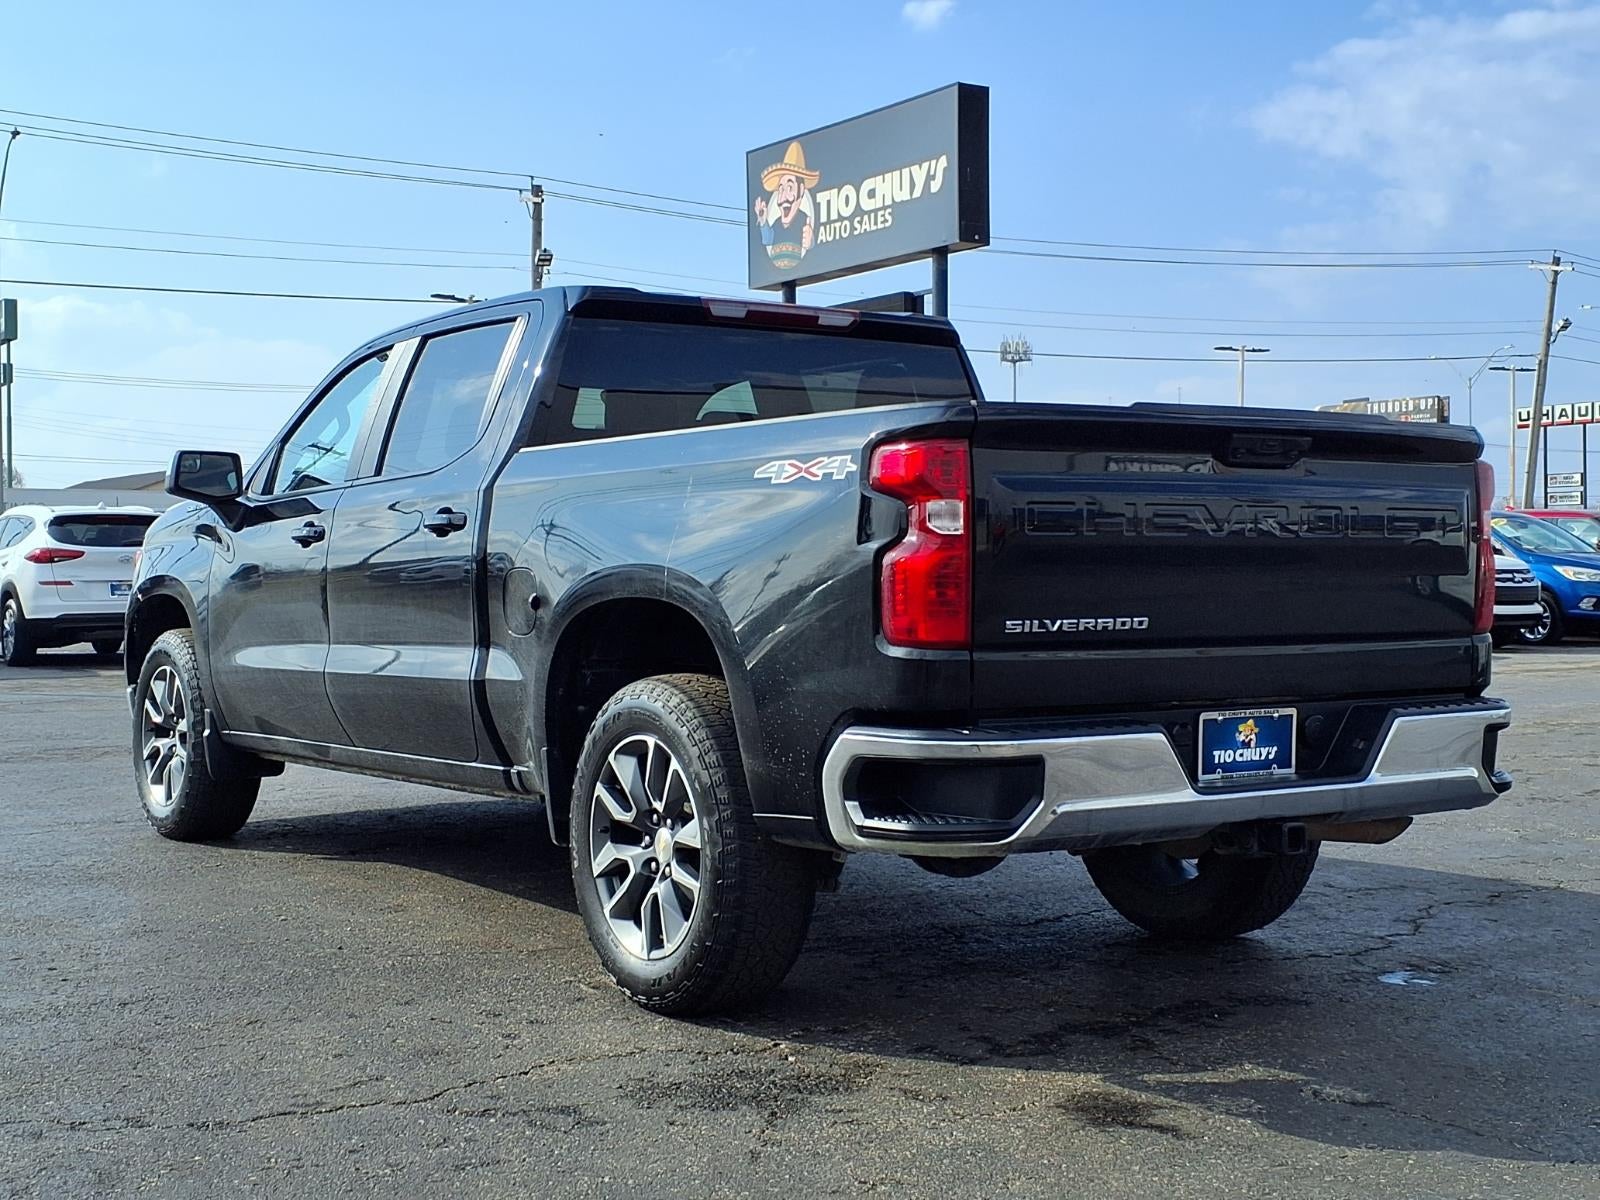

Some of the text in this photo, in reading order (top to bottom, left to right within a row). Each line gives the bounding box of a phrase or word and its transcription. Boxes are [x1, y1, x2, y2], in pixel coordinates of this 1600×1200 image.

[816, 154, 948, 223] TIO CHUY'S
[817, 208, 893, 244] AUTO SALES
[1367, 397, 1438, 415] THUNDER UP!
[1024, 499, 1460, 539] CHEVROLET
[1004, 616, 1150, 634] SILVERADO
[1213, 746, 1278, 763] TIO CHUY'S
